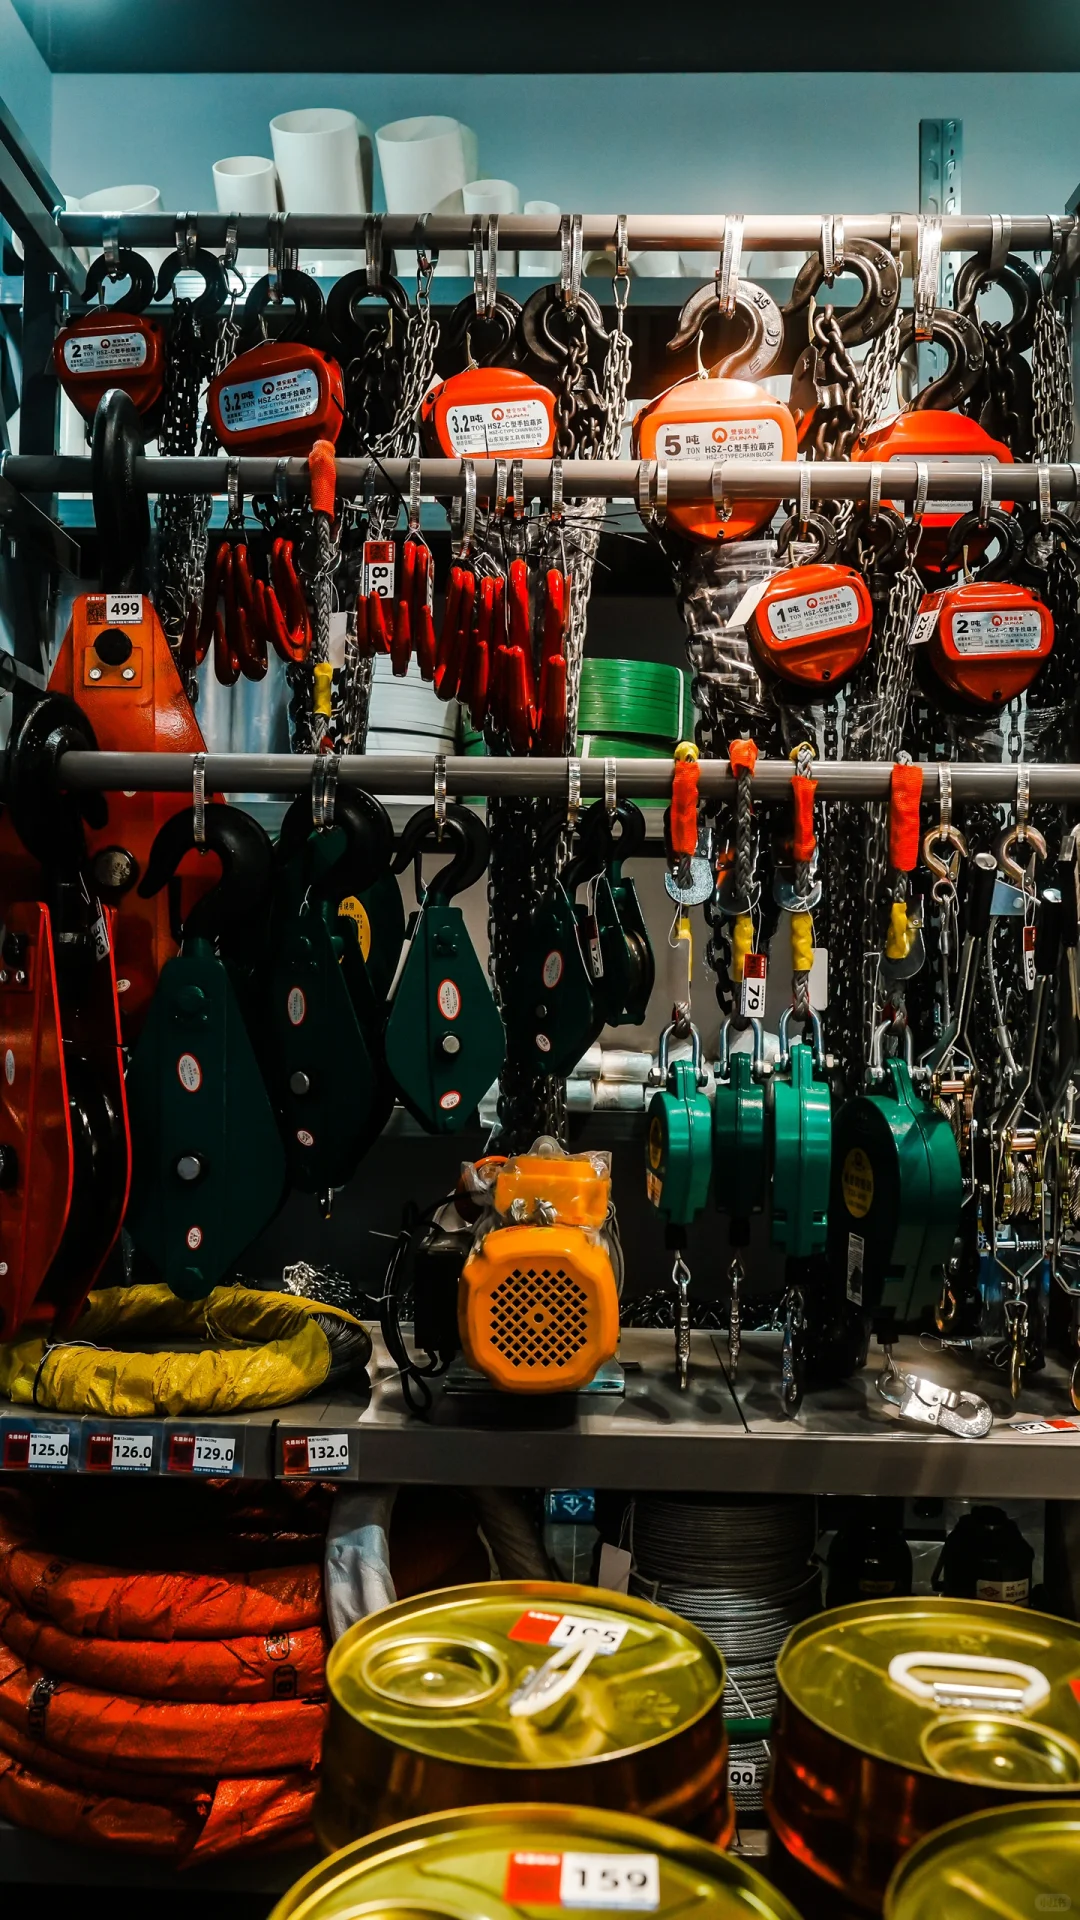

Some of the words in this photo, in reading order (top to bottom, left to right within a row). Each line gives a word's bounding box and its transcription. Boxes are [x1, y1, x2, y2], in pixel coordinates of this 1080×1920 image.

[72, 344, 82, 358] 2
[224, 392, 241, 412] 3.2
[241, 391, 254, 400] 吨
[452, 414, 470, 434] 3.2
[470, 414, 484, 422] 吨
[471, 424, 484, 432] TON
[664, 434, 682, 456] 5
[686, 434, 700, 444] 吨
[704, 442, 774, 454] HSZ-C型手拉葫芦
[110, 602, 140, 616] 499
[776, 608, 786, 622] 1
[788, 606, 800, 614] 吨
[914, 616, 930, 640] 229
[956, 620, 969, 634] 2
[748, 984, 760, 1010] 79
[31, 1444, 68, 1456] 125.0
[114, 1446, 152, 1458] 126.0
[196, 1446, 234, 1462] 129.0
[310, 1444, 348, 1459] 132.0
[575, 1867, 647, 1891] 159
